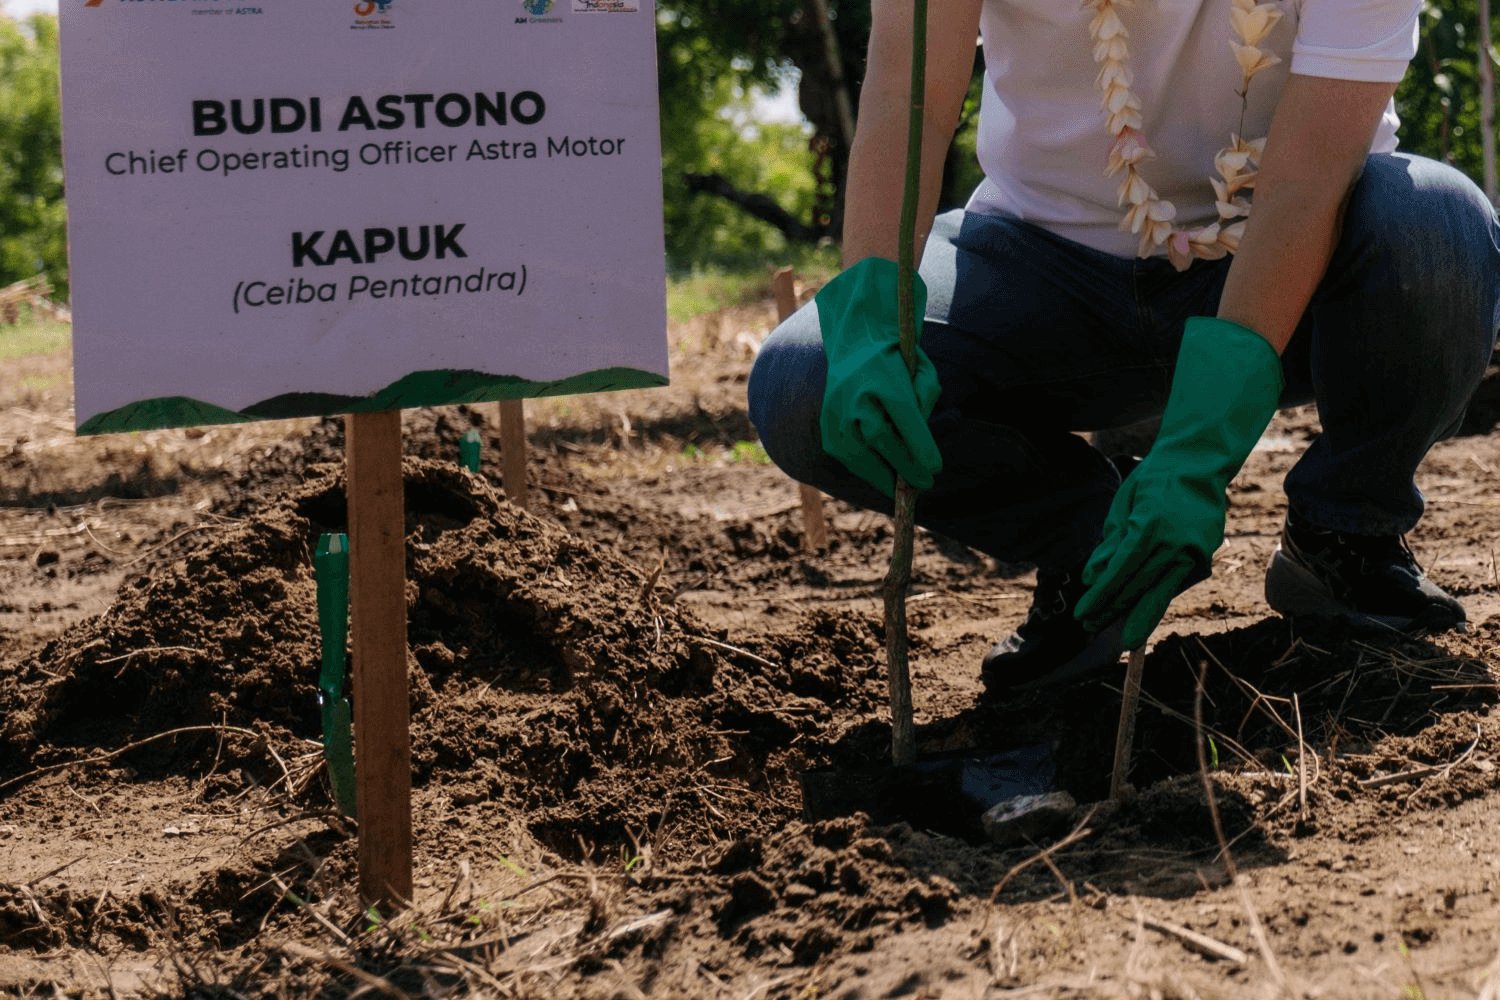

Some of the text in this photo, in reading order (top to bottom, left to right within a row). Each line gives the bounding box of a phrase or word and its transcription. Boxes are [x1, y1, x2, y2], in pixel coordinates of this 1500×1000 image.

[235, 7, 264, 15] ASTRA
[192, 90, 546, 136] BUDI ASTONO
[104, 136, 626, 177] Chief Operating Officer Astra Motor
[291, 223, 468, 267] KAPUK
[233, 265, 527, 314] (Ceiba Pentandra)
